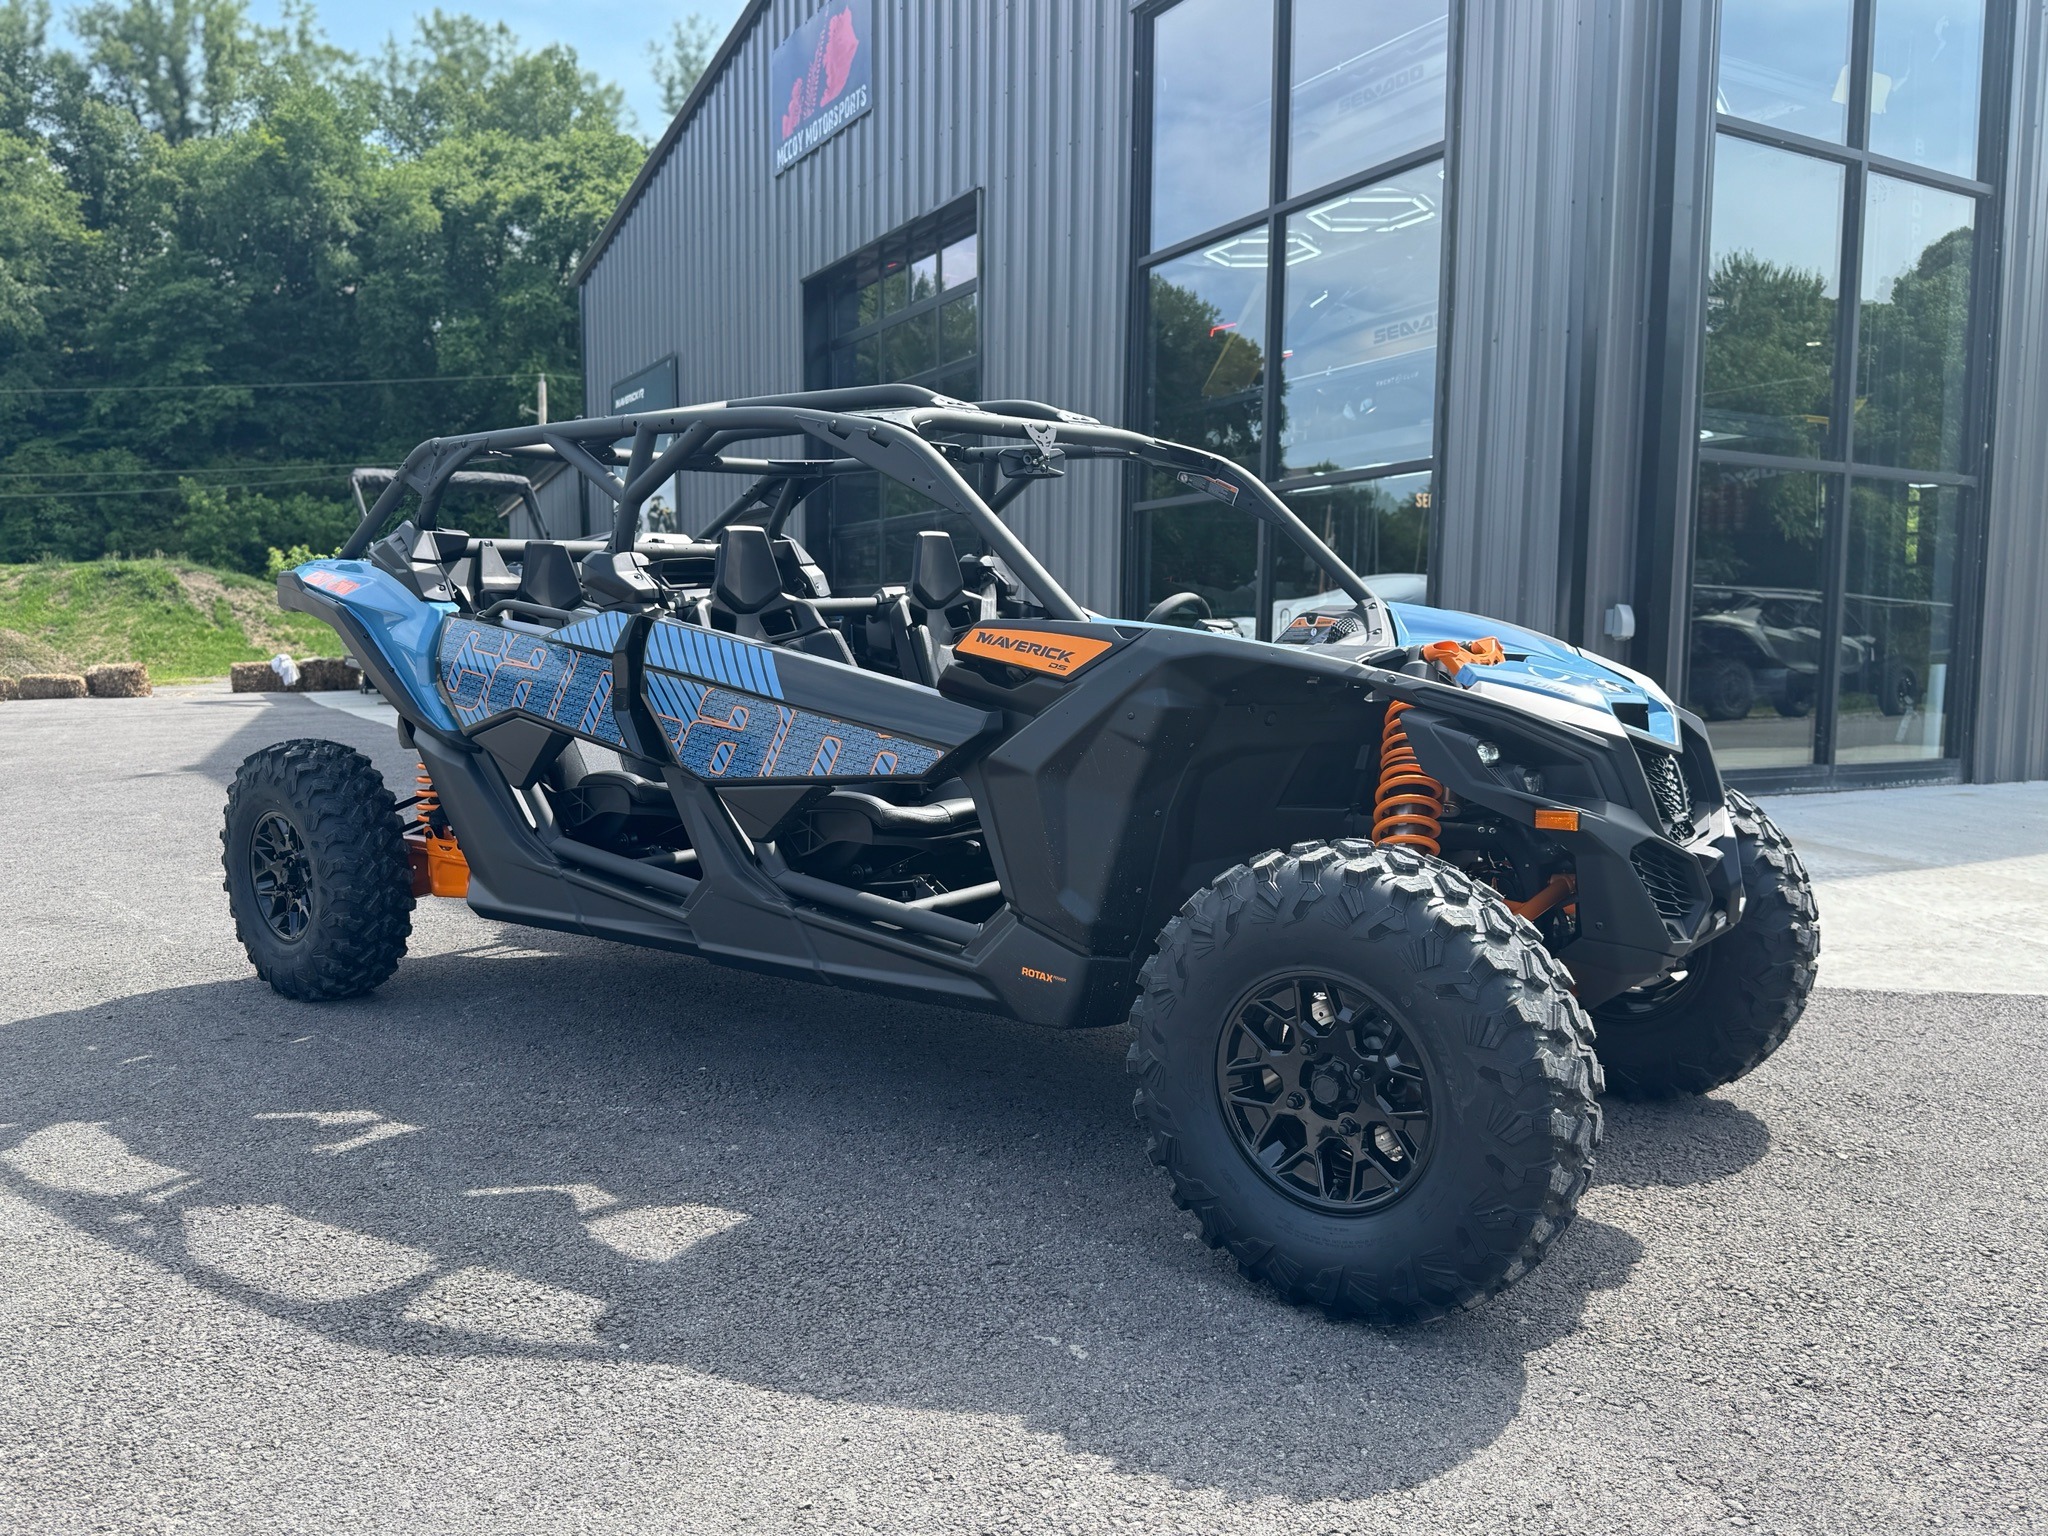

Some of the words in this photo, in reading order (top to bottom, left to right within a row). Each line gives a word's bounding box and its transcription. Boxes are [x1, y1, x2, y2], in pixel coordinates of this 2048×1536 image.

[777, 130, 804, 168] MCCOY
[805, 84, 867, 148] MOTORSPORTS
[976, 631, 1076, 663] MAVERICK
[1047, 662, 1068, 671] DS
[1021, 966, 1053, 983] ROTAX
